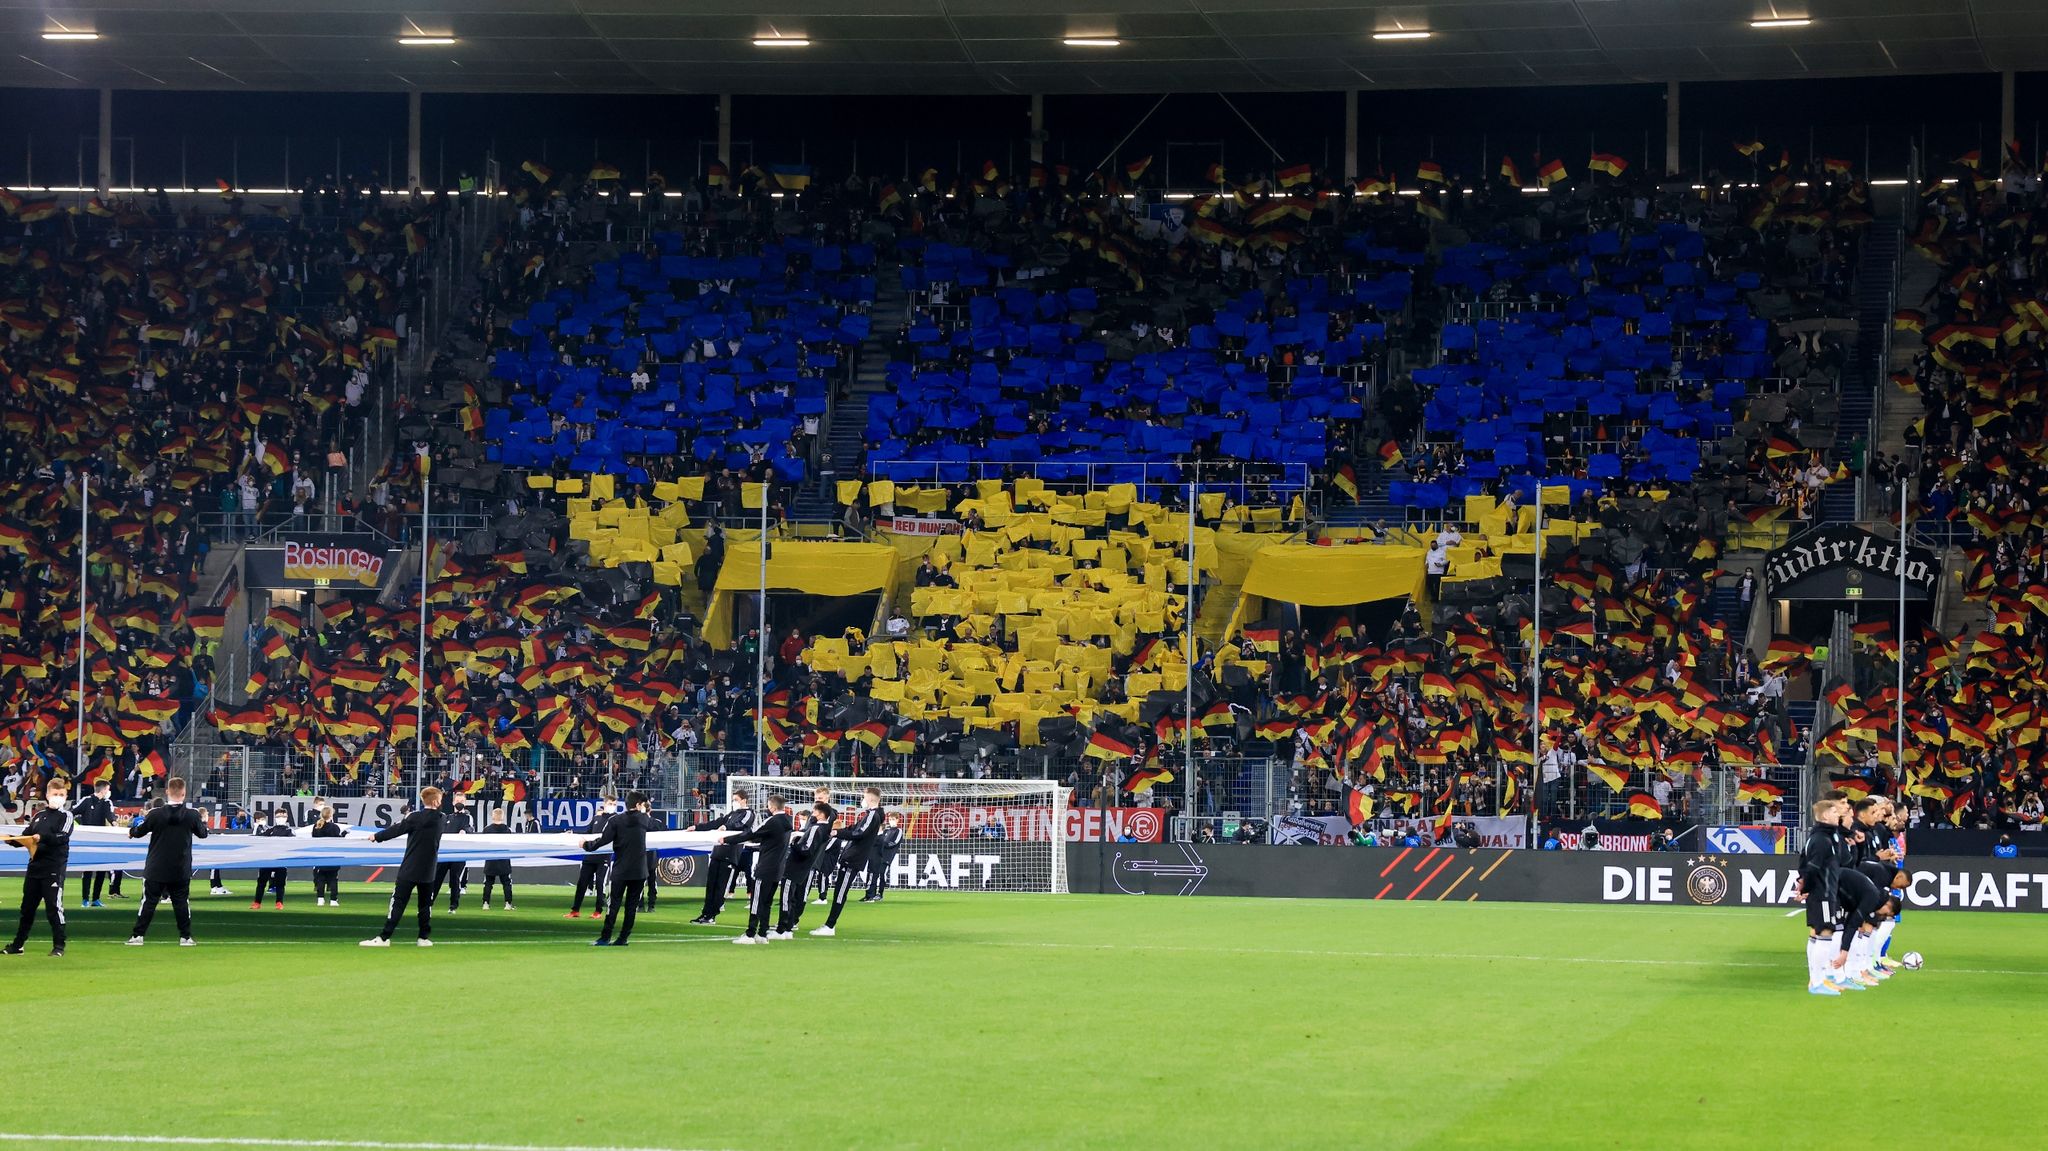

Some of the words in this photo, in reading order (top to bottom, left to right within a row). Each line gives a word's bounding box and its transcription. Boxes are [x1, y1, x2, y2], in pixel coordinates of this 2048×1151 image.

[895, 520, 915, 532] RED
[285, 541, 383, 577] Bösingen
[256, 801, 349, 826] HALE
[1394, 819, 1437, 833] PLAT
[1452, 819, 1475, 831] FR
[1560, 832, 1648, 852] SCBRONN
[1603, 866, 1673, 901] DIE
[1739, 869, 2048, 909] MACHAFT
